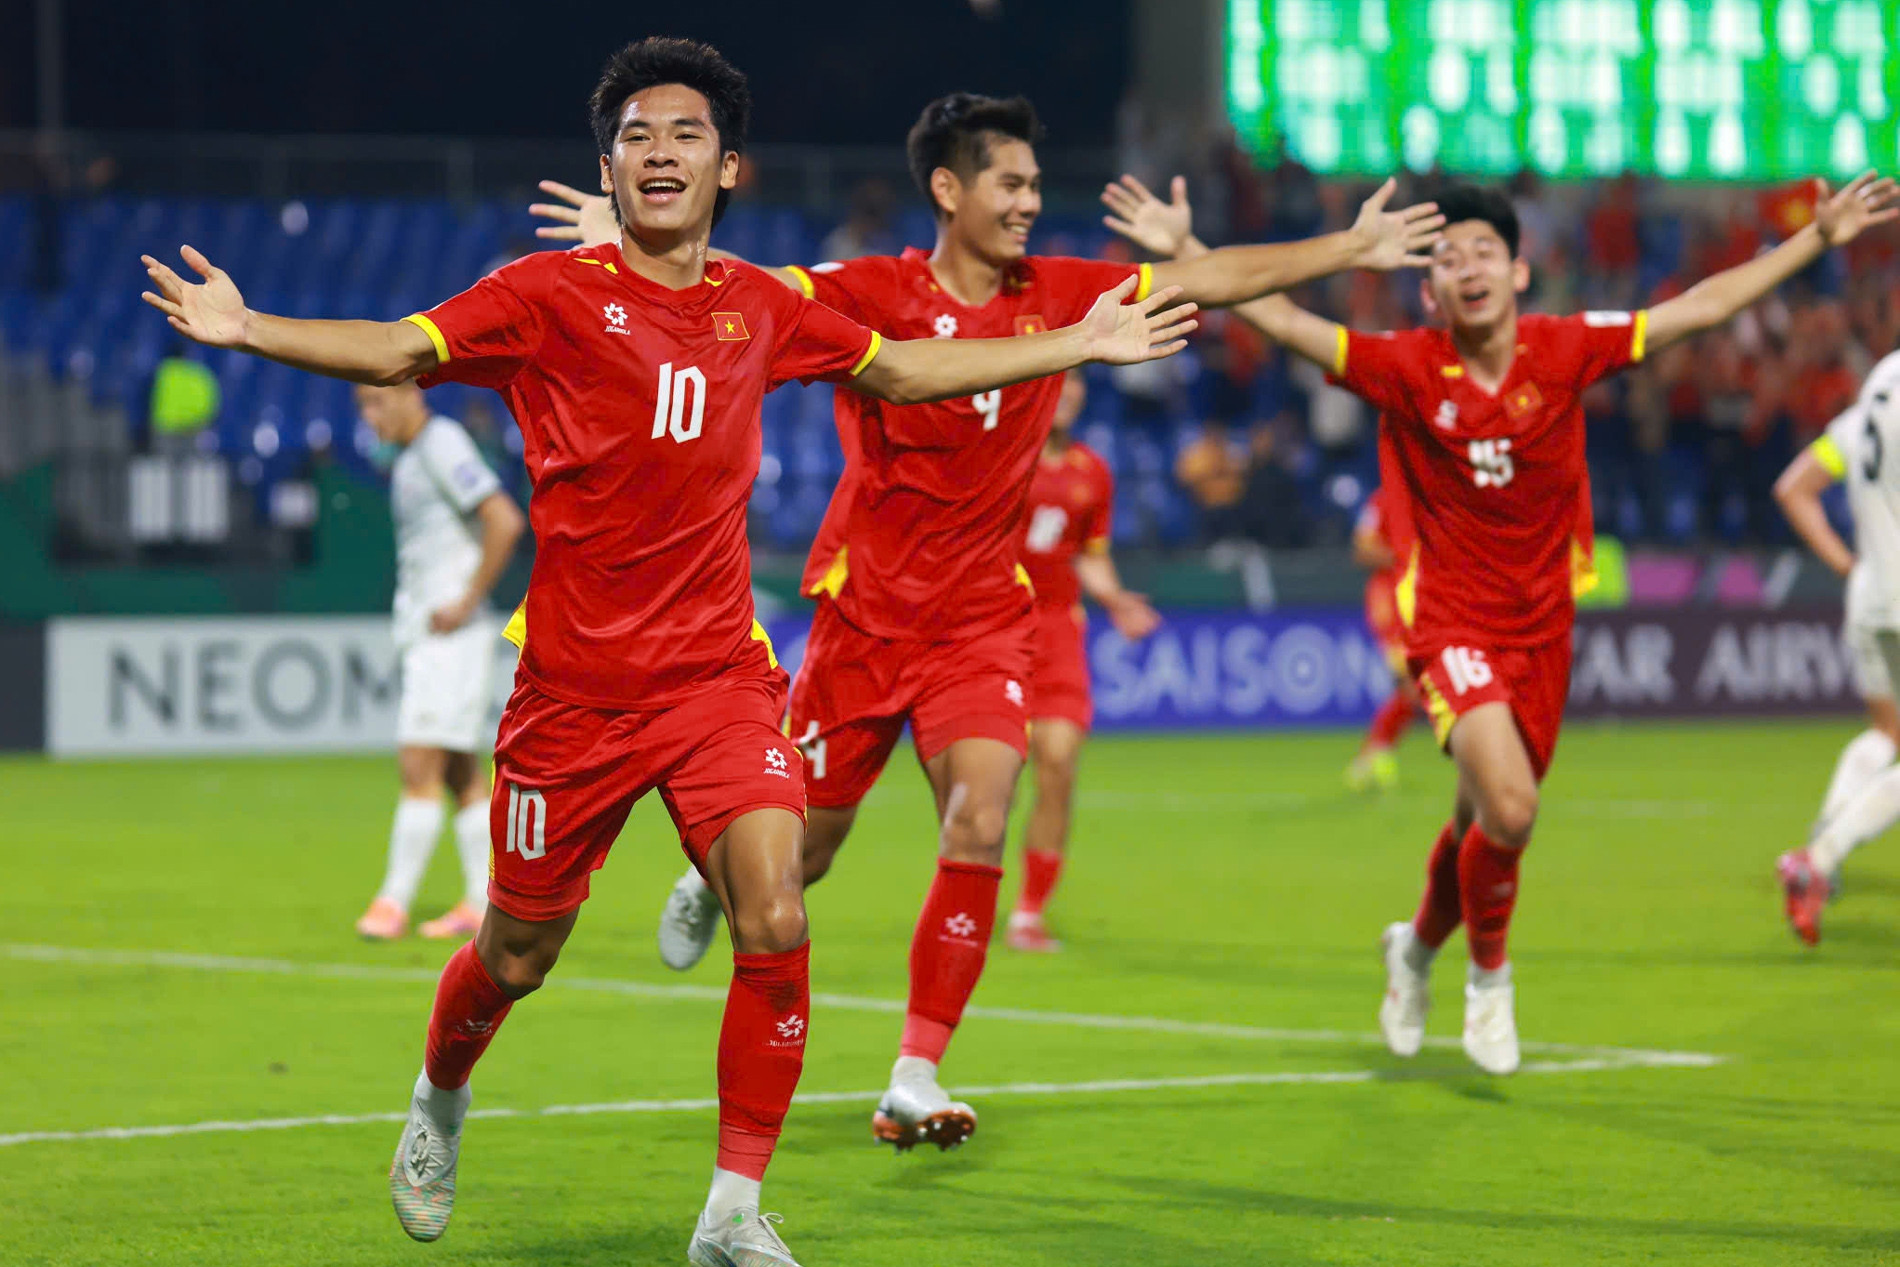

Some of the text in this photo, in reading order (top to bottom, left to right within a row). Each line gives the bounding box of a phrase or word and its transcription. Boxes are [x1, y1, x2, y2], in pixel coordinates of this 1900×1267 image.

[651, 362, 706, 444] 10
[106, 637, 402, 733] NEOM
[1092, 622, 1394, 717] SAISON
[1442, 645, 1494, 696] 16
[1570, 622, 1675, 703] AR
[506, 782, 547, 861] 10
